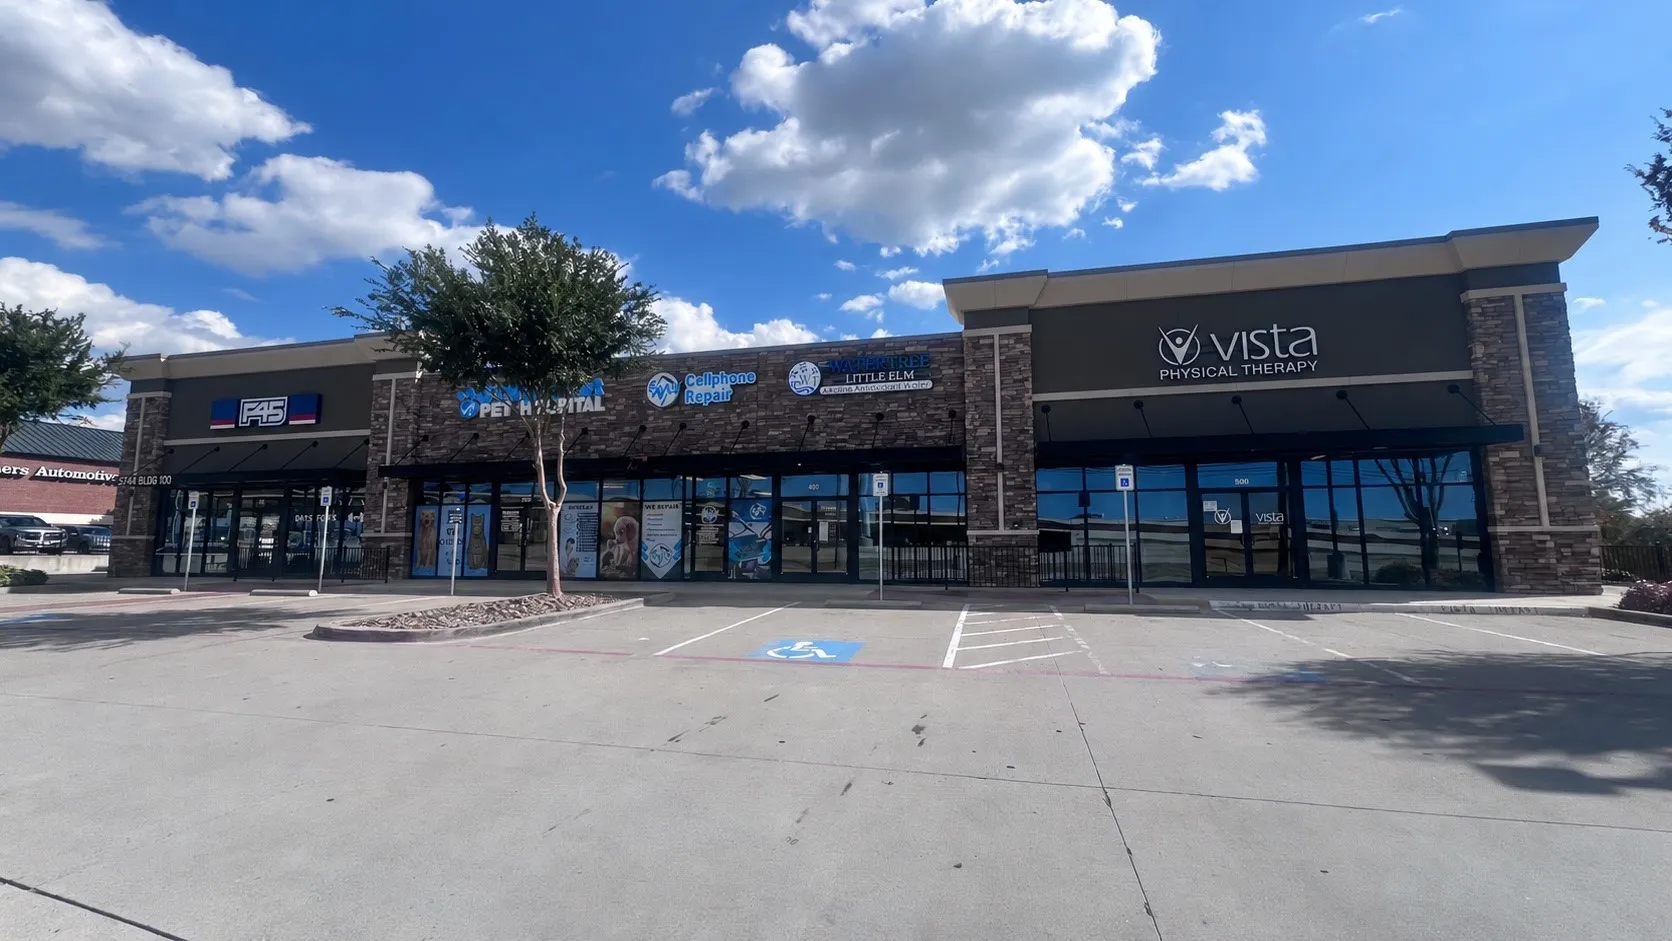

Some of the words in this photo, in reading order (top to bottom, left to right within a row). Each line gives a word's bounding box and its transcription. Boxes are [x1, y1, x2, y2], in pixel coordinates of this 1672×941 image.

[846, 371, 886, 383] LITTLE
[889, 370, 915, 380] ELM
[1160, 366, 1238, 380] PHYSICAL
[1241, 360, 1318, 375] THERAPY
[685, 371, 756, 388] Cellphone
[685, 388, 733, 406] Repair
[242, 399, 286, 423] F45
[479, 401, 513, 418] PET
[0, 465, 29, 475] ers
[138, 475, 158, 485] BLDG
[159, 475, 172, 485] 100
